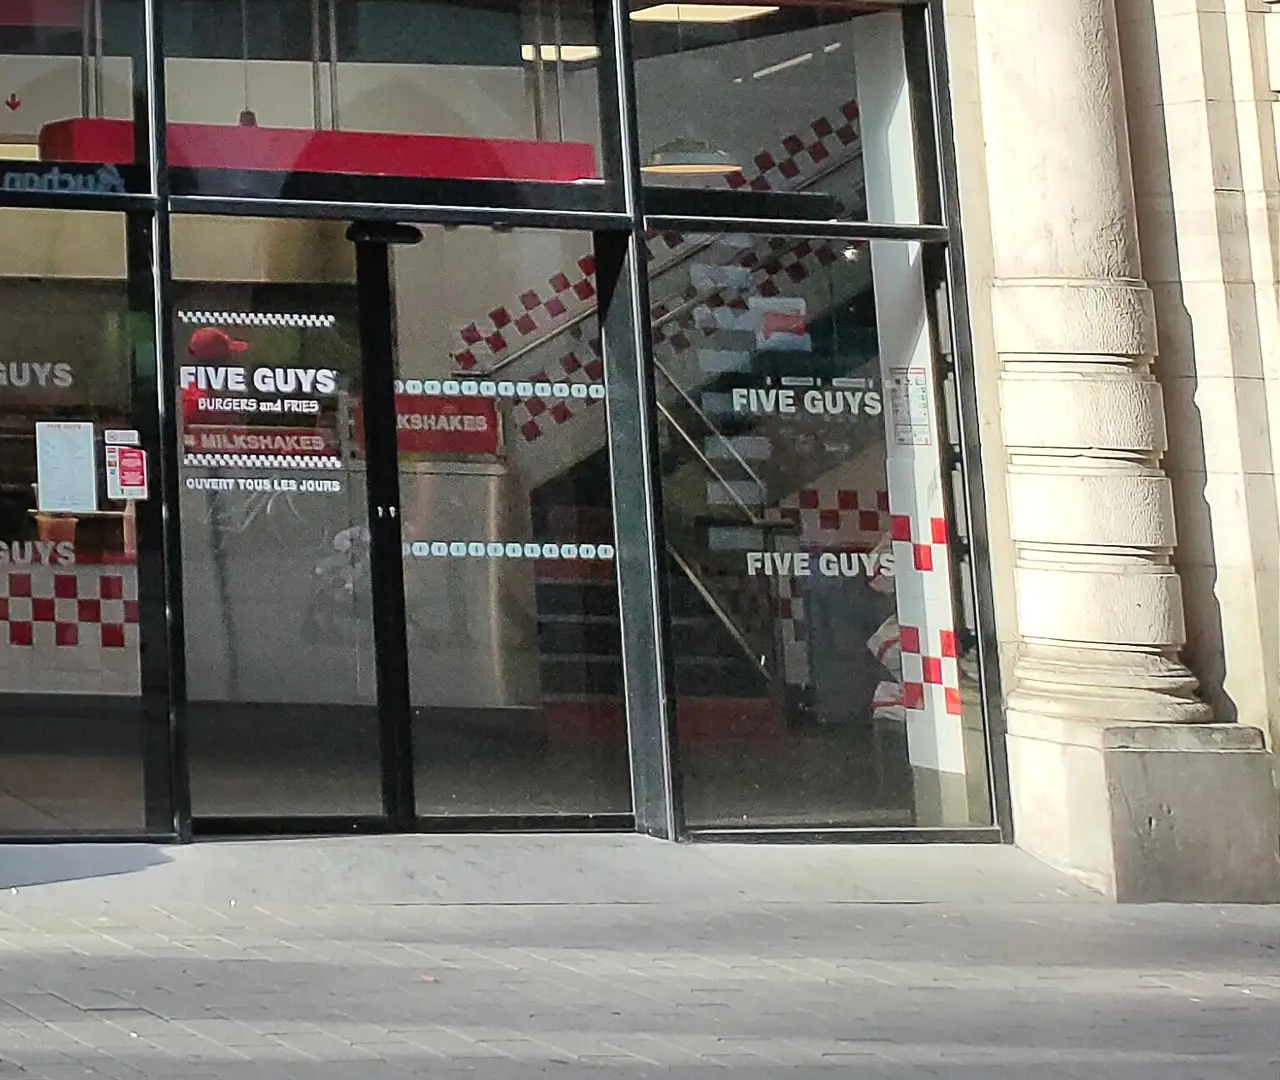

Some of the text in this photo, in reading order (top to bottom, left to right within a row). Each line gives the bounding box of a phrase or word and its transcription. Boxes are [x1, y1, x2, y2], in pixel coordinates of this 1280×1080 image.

[179, 366, 337, 394] FIVE GUYS
[198, 397, 319, 413] BURGERS and FRIES
[732, 388, 882, 416] FIVE GUYS
[396, 413, 488, 432] KSHAKES
[199, 433, 326, 451] MILKSHAKES
[186, 478, 340, 493] OUVERT TOUS LES JOURS
[746, 552, 899, 578] FIVE GUYS
